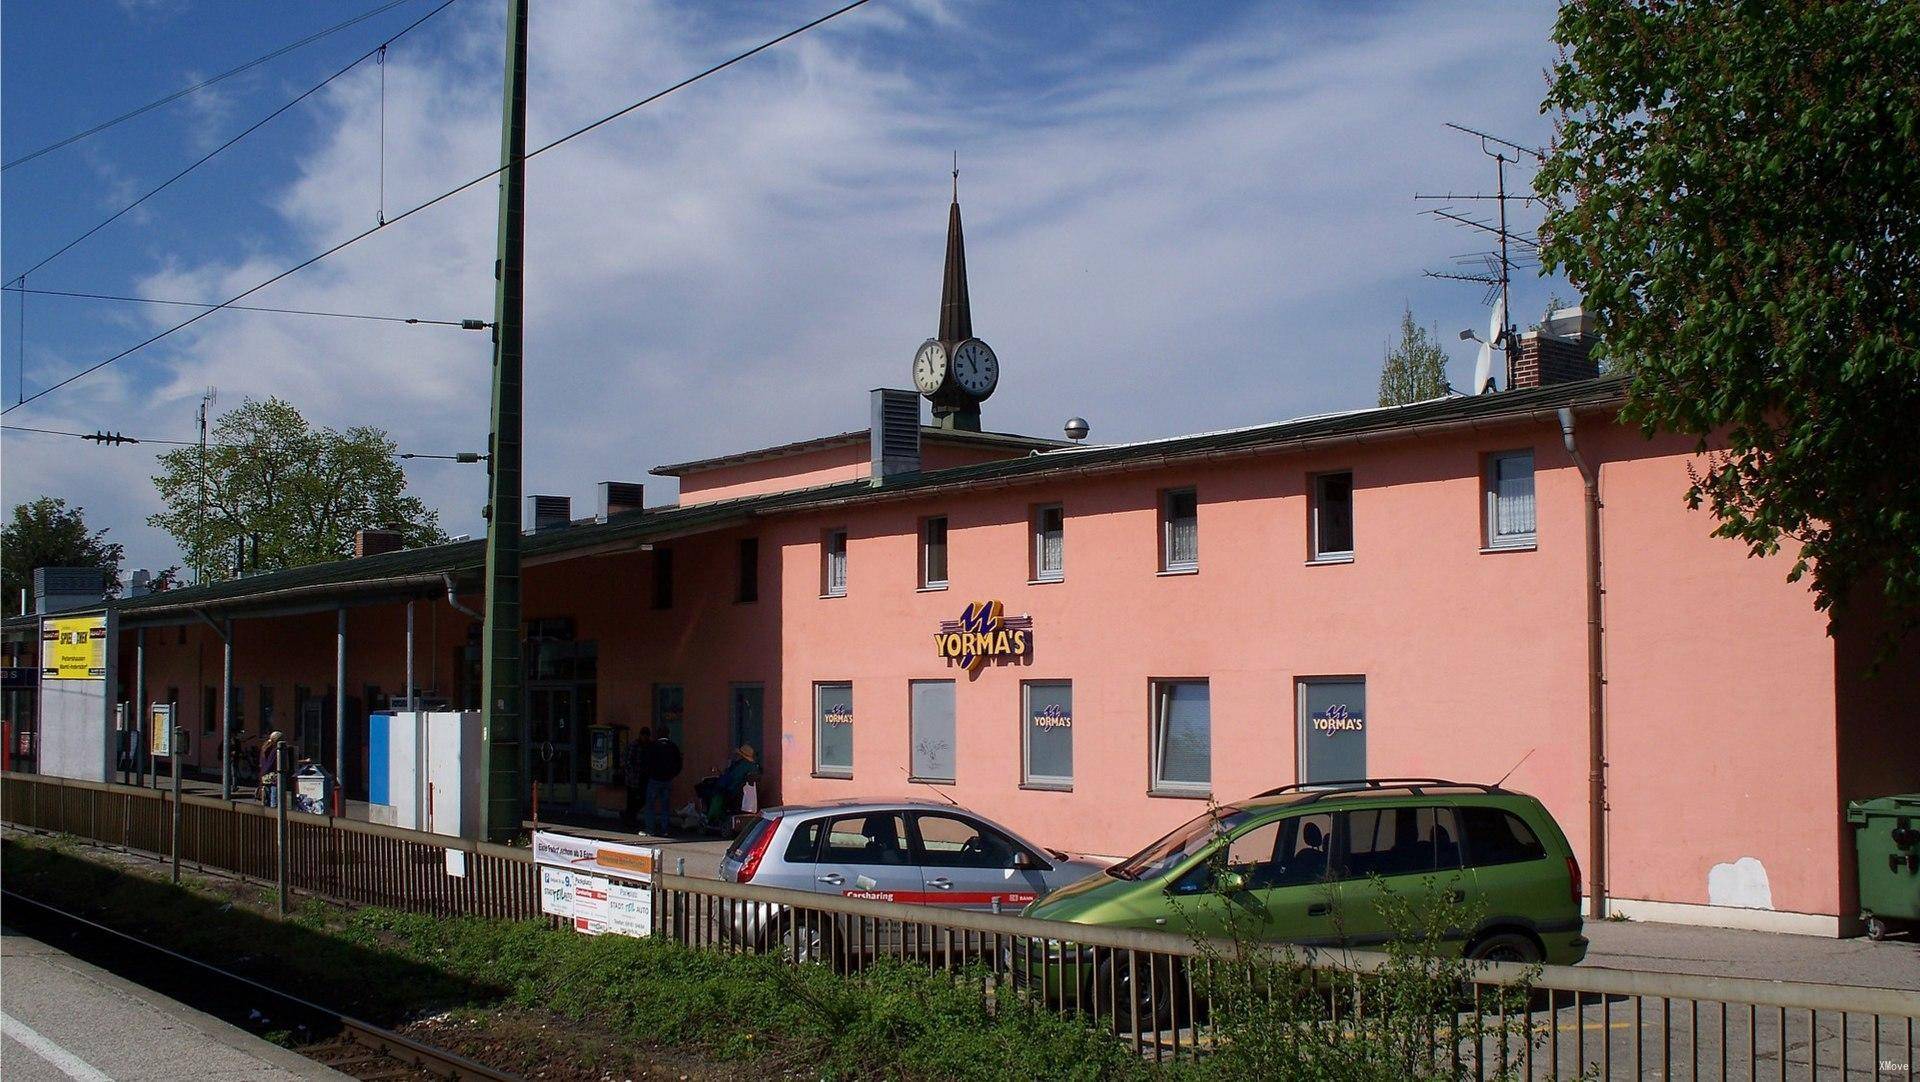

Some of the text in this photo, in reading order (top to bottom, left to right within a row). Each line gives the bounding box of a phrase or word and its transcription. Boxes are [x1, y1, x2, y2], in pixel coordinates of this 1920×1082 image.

[935, 630, 1026, 657] YORMA'S
[824, 713, 853, 724] YORMA'S
[1034, 716, 1072, 728] YORMA'S
[1313, 718, 1363, 730] YORMA'S
[846, 891, 894, 902] Carsharing
